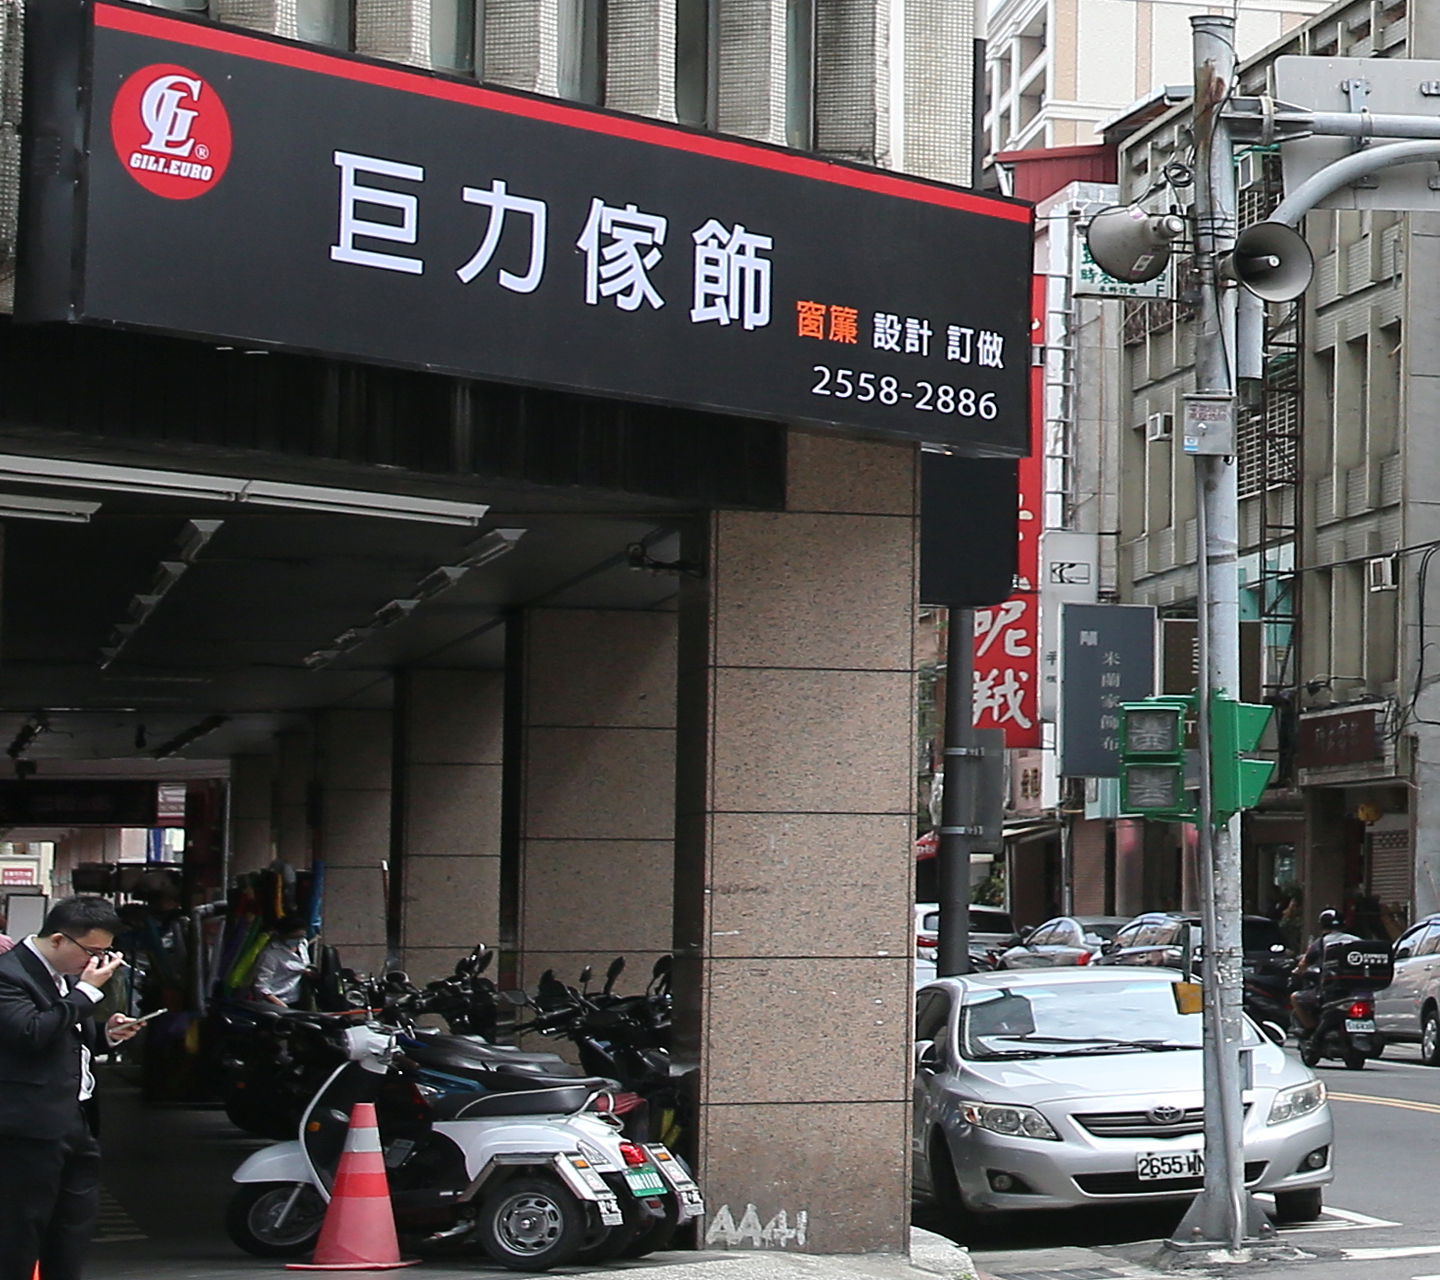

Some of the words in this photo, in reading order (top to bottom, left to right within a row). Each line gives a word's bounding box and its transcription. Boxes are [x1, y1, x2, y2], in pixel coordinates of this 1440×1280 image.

[129, 152, 214, 182] GILI.EURO
[330, 149, 774, 331] 巨力傢飾
[795, 300, 859, 345] 窗簾
[872, 312, 933, 357] 設計
[946, 324, 1005, 369] 訂做
[811, 365, 998, 421] 2558-2886
